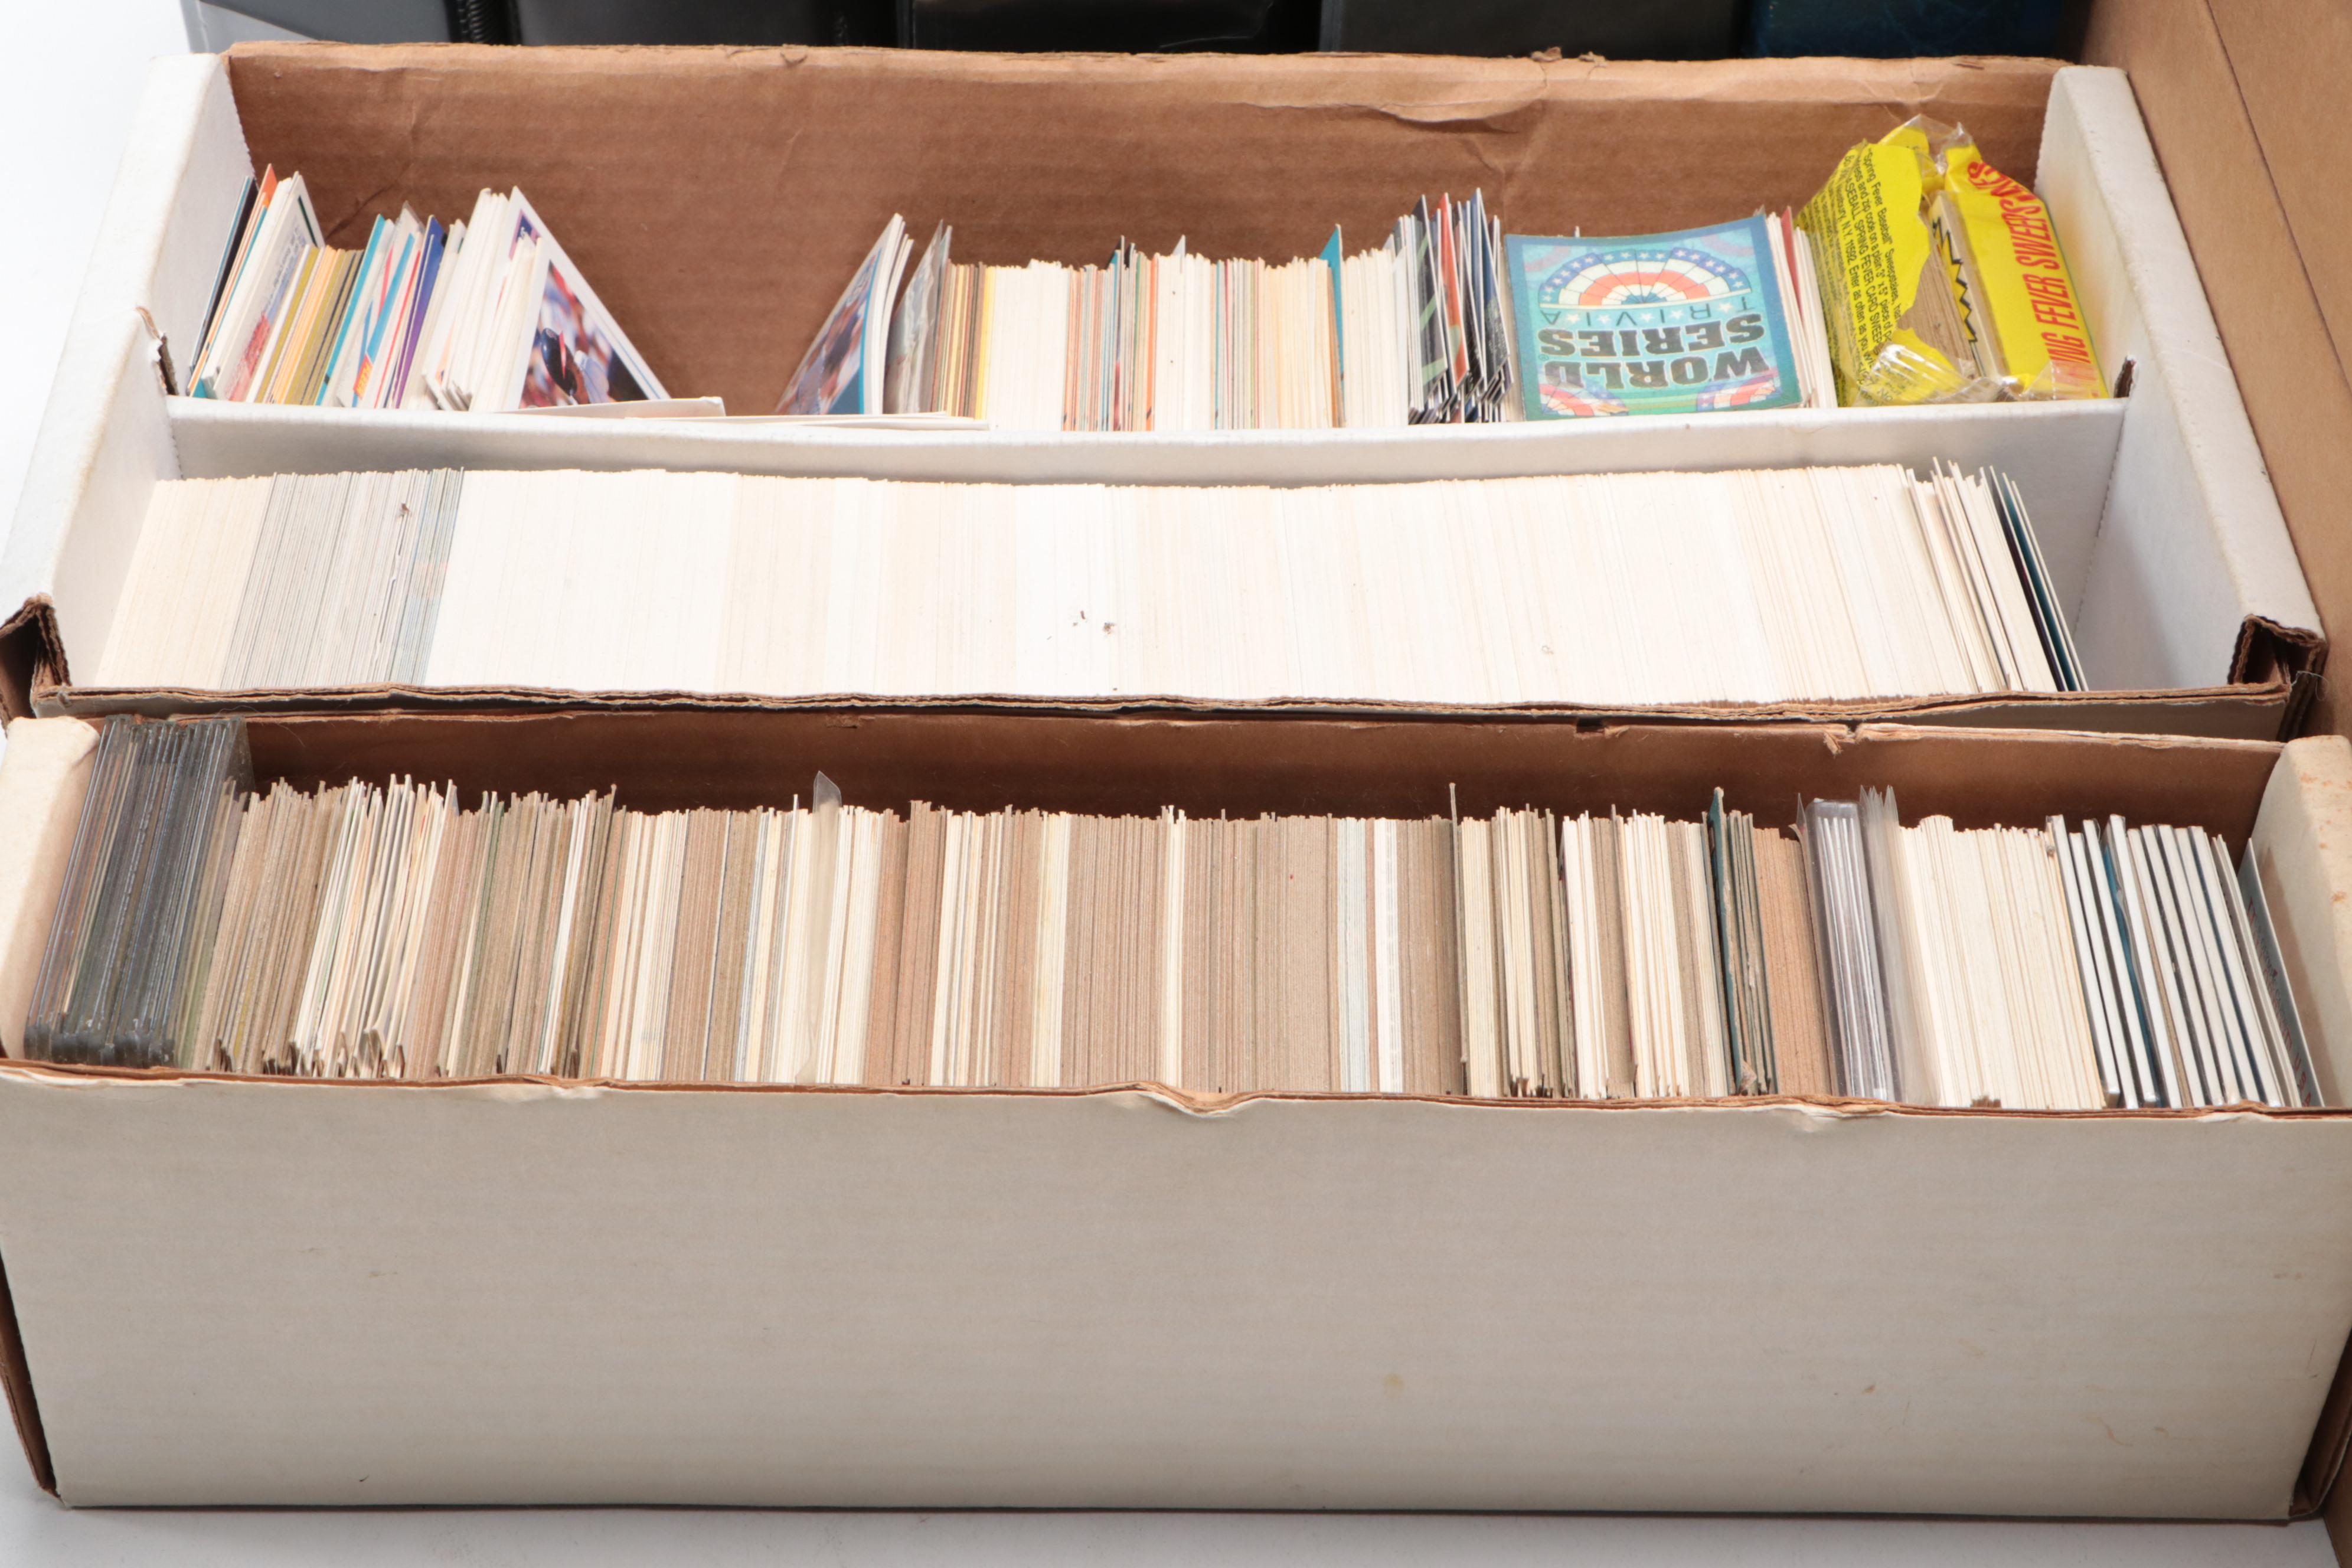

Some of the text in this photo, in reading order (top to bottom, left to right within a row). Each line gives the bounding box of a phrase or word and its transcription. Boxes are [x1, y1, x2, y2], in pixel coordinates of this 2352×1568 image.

[1858, 182, 1870, 200] and
[1862, 199, 1871, 213] zip
[1866, 212, 1876, 233] code
[1854, 220, 1868, 256] SPRING
[1869, 232, 1877, 244] on
[1871, 182, 1883, 206] Fever
[1885, 248, 1899, 305] Sweepstakes,
[1871, 243, 1879, 251] a
[1860, 254, 1874, 286] FEVER
[1872, 250, 1882, 271] plain
[1849, 264, 1860, 288] Enter
[1853, 289, 1861, 300] as
[1866, 286, 1879, 312] CARD
[2022, 273, 2080, 331] FEVER
[1539, 296, 1756, 326] TRIVIA
[1855, 301, 1865, 324] often
[1879, 299, 1889, 322] piece
[1537, 313, 1765, 357] SERIES
[1858, 324, 1867, 335] as
[1883, 321, 1893, 331] of
[1858, 335, 1868, 351] you
[1543, 346, 1770, 389] WORLD
